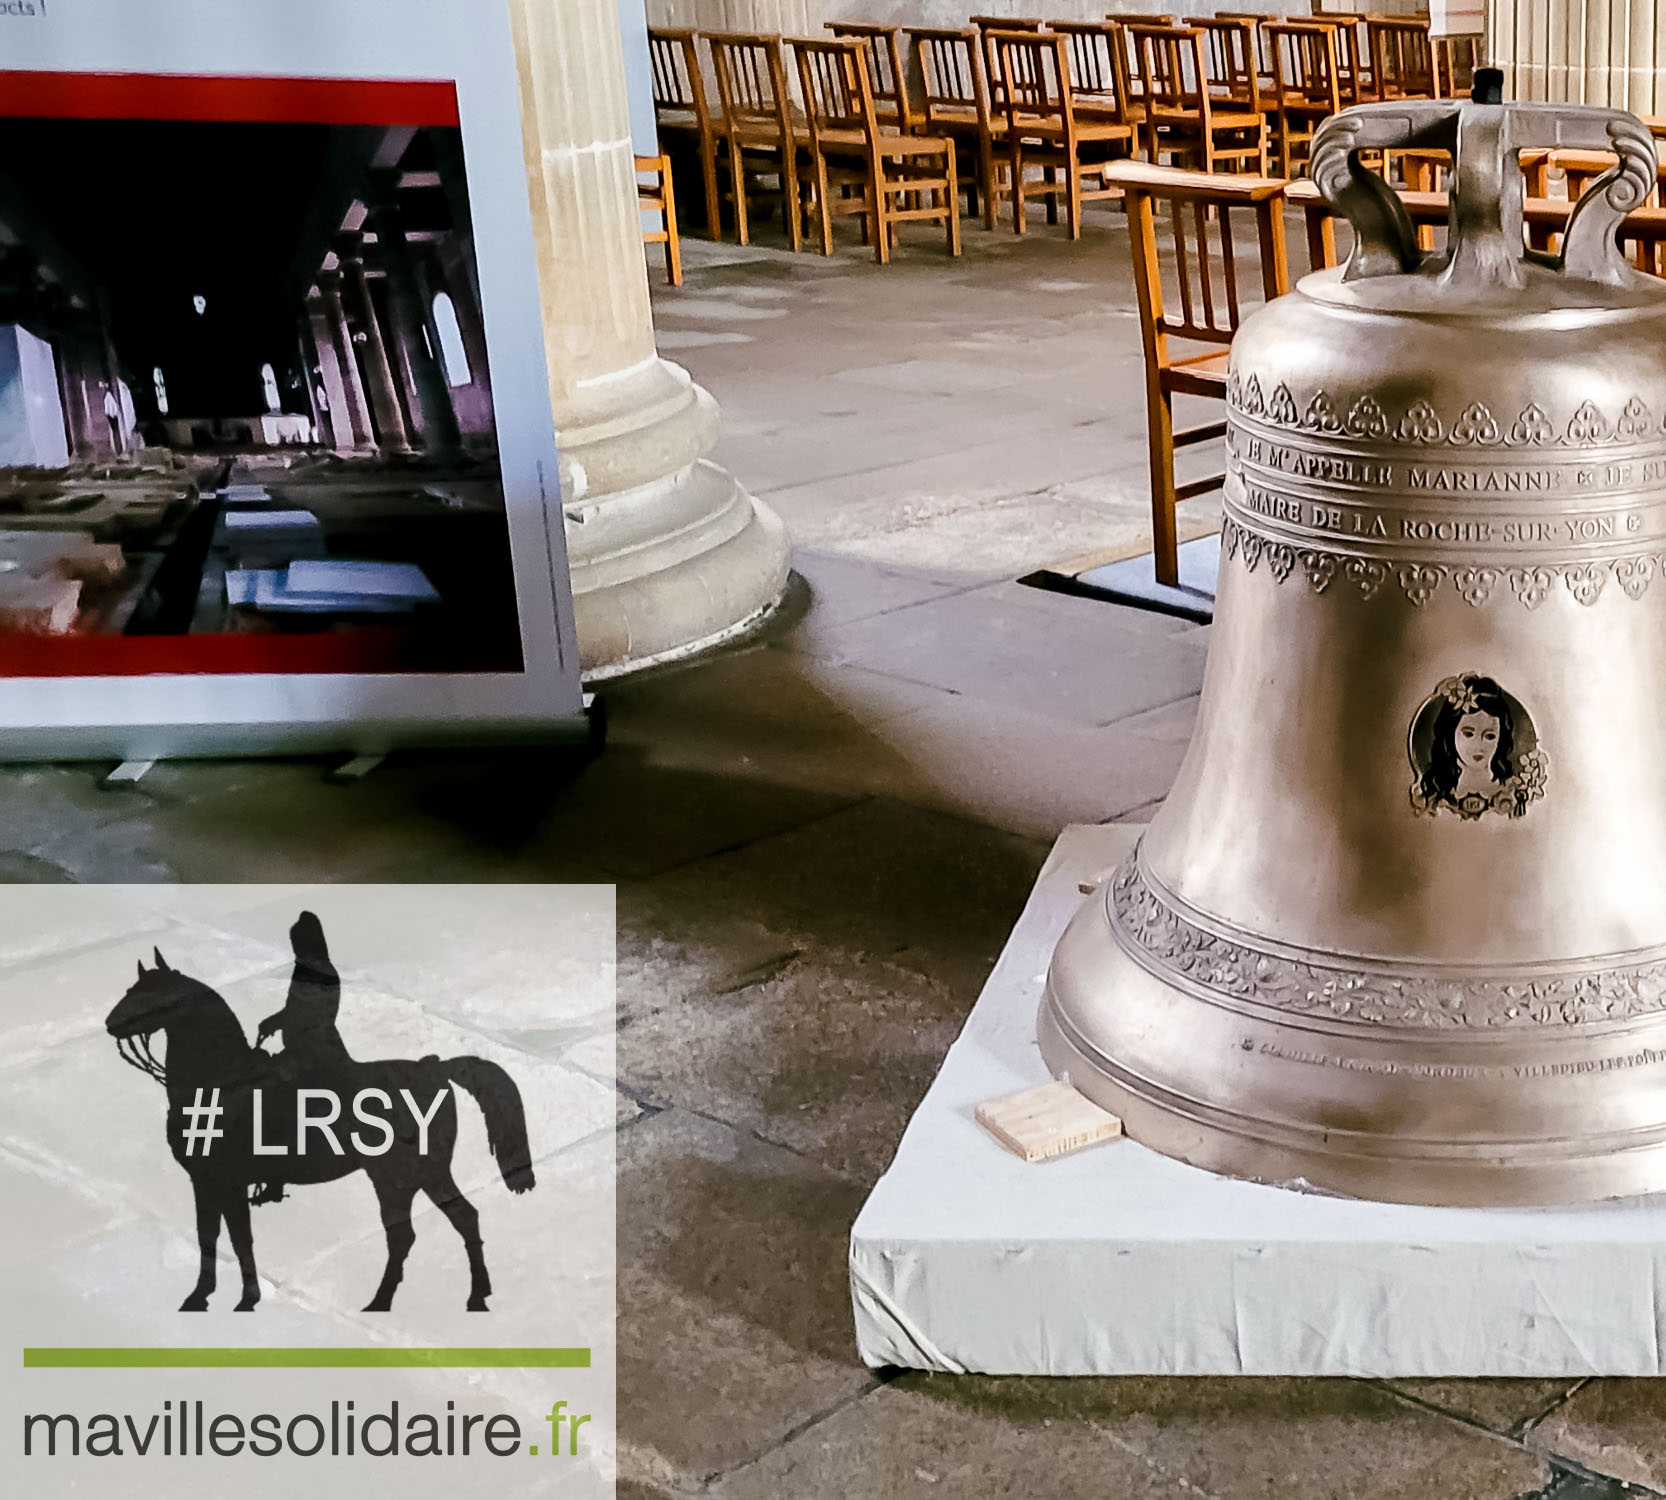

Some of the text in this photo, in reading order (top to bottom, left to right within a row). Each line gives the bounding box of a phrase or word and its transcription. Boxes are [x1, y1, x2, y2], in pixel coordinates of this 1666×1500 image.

[1408, 467, 1560, 492] MARIANNE
[1605, 465, 1632, 487] JE
[1249, 488, 1301, 522] MAIRE
[1311, 505, 1342, 529] DE
